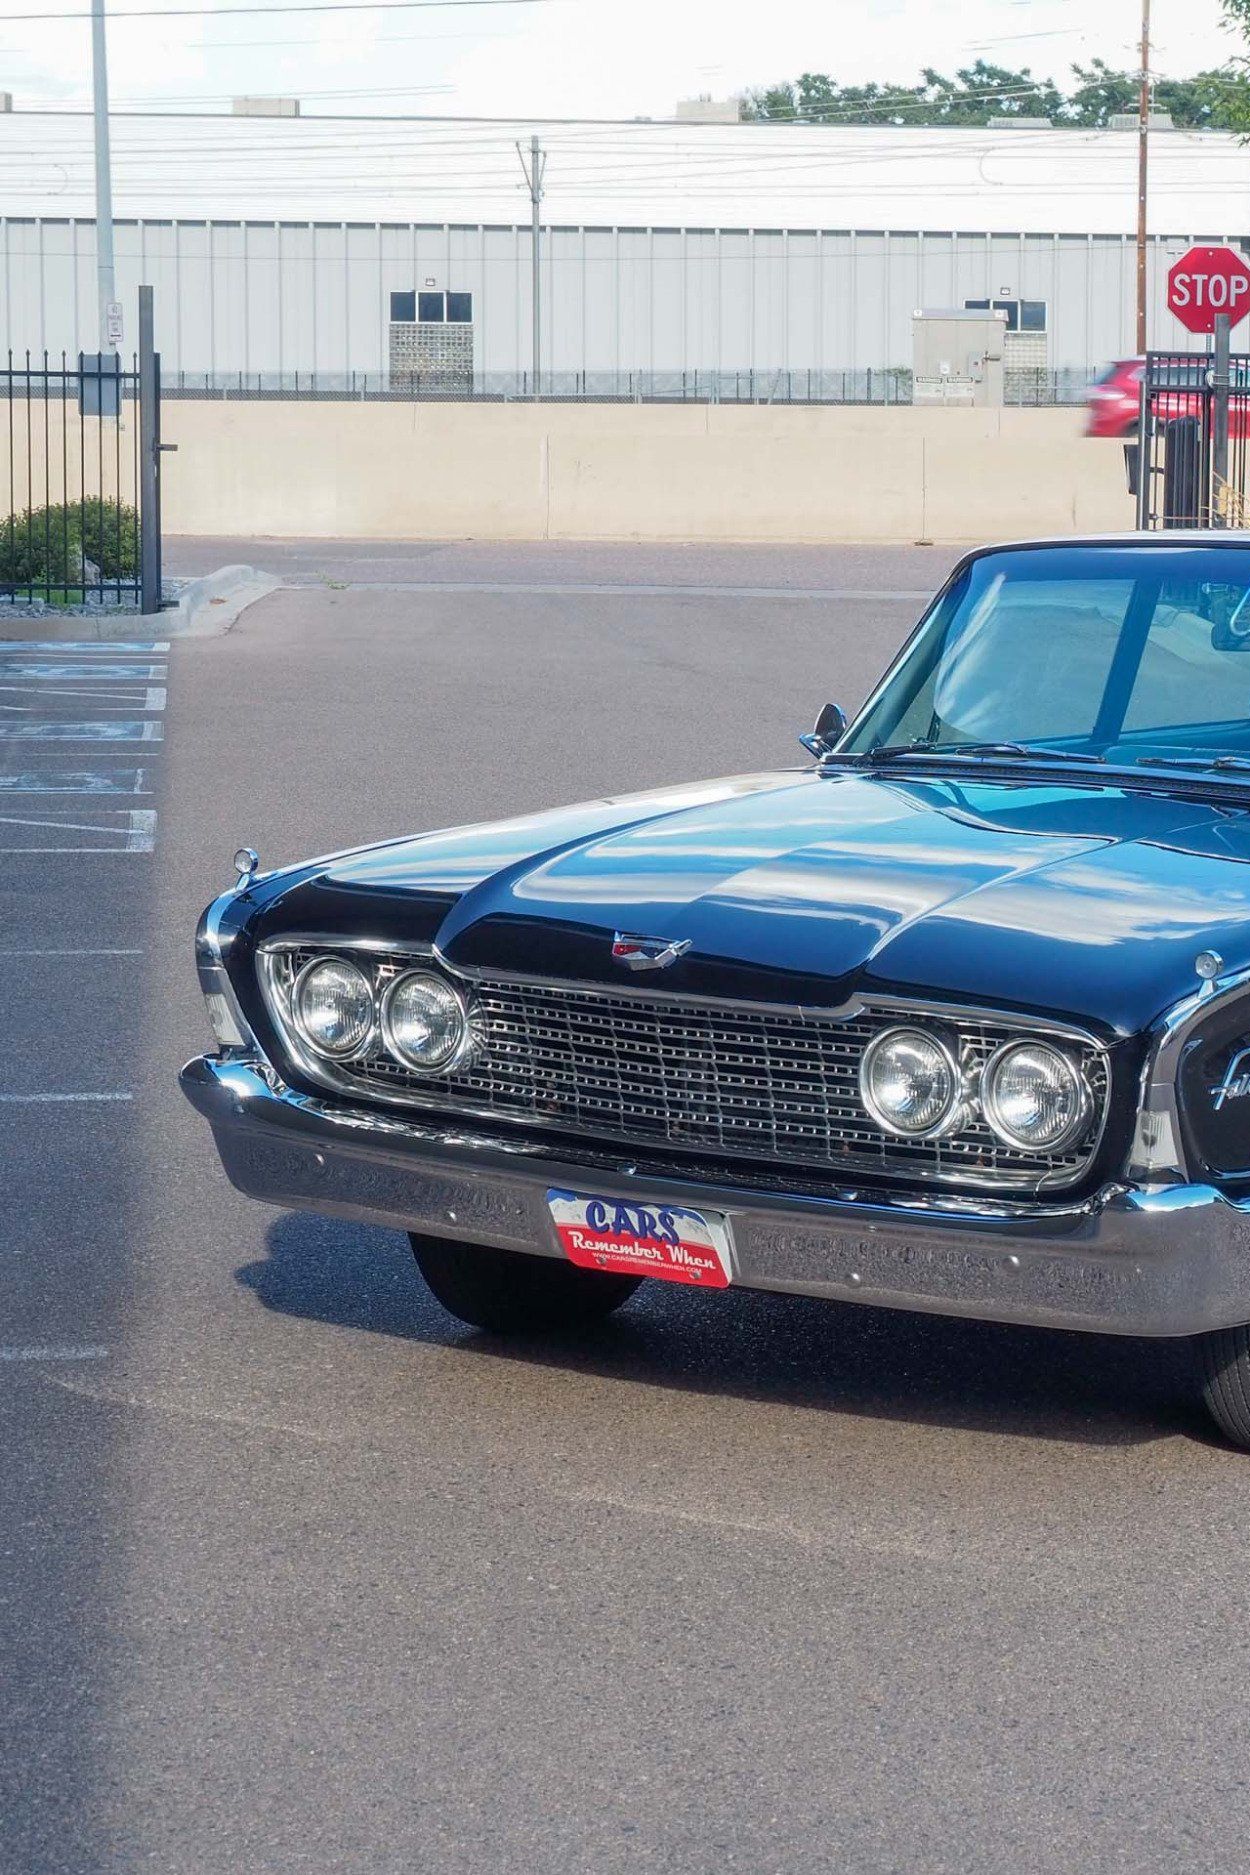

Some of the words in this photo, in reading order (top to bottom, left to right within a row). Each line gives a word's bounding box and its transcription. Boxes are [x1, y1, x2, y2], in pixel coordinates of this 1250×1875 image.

[1172, 273, 1249, 307] STOP
[586, 1201, 680, 1245] CARS
[567, 1231, 664, 1260] Remember
[666, 1245, 717, 1269] When
